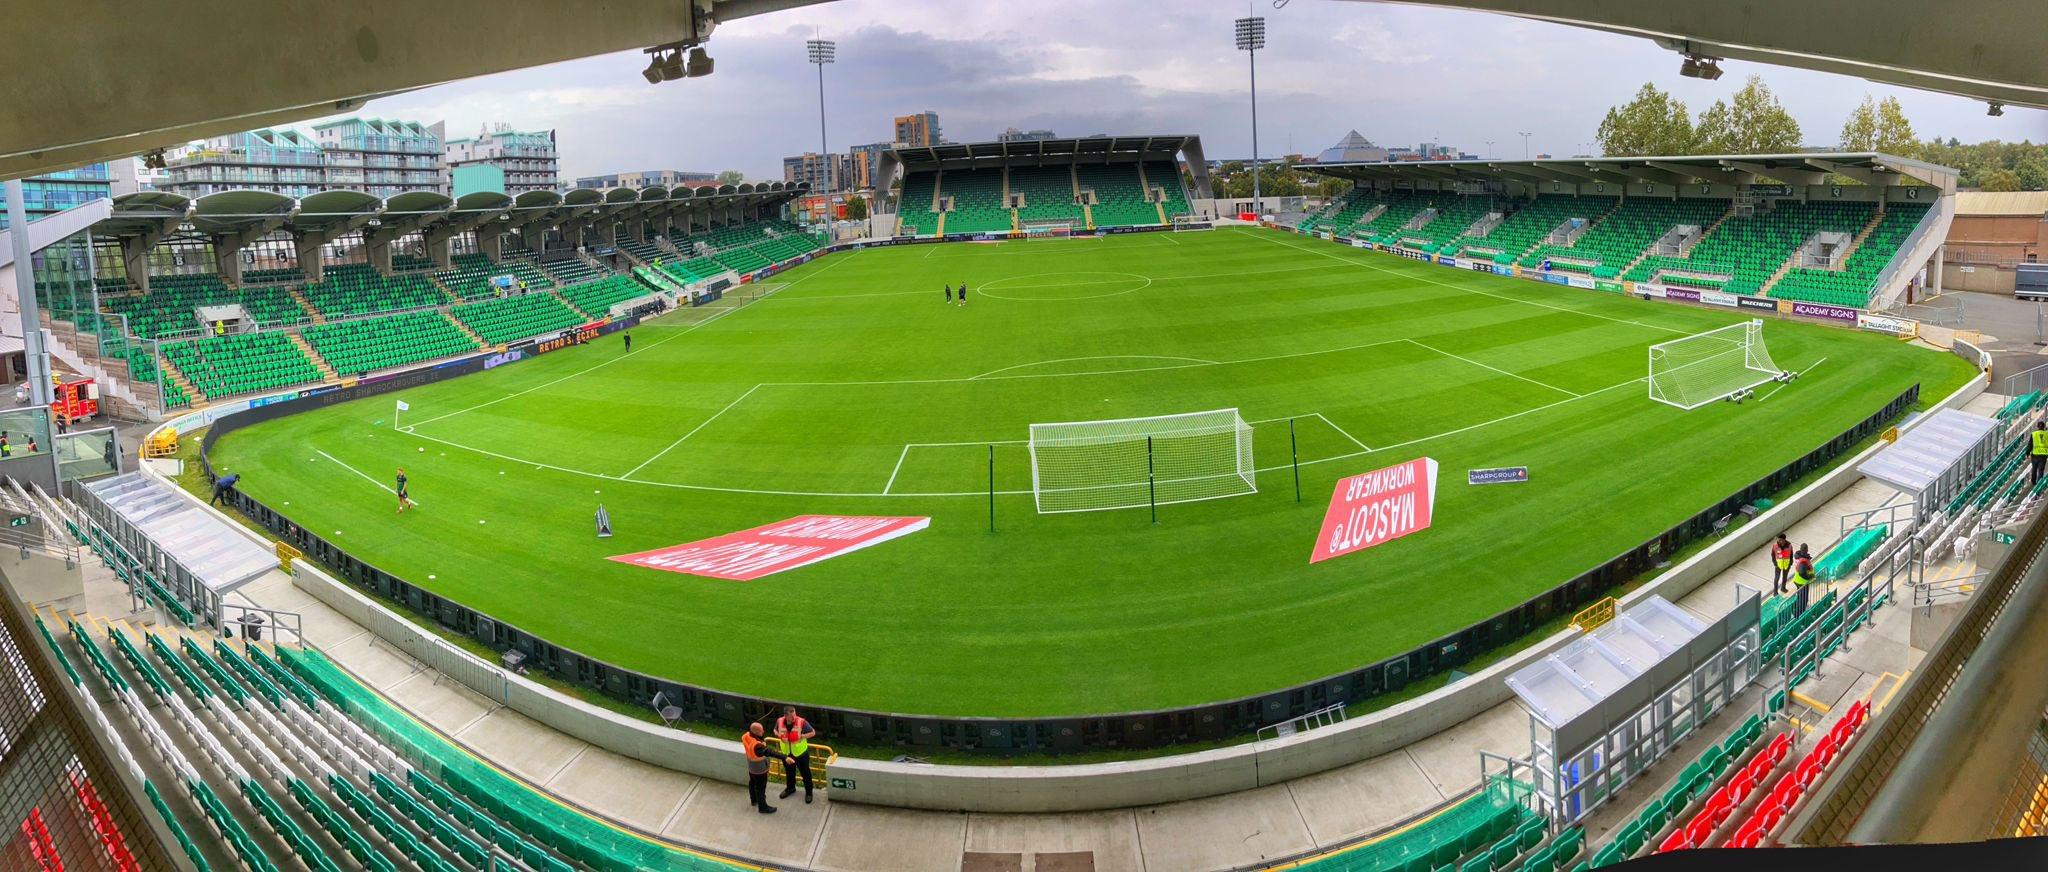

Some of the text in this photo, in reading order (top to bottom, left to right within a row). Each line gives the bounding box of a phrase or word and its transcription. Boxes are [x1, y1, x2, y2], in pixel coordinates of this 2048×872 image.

[175, 256, 183, 266] B
[244, 255, 252, 264] B
[1741, 299, 1773, 308] SKECHERS
[1795, 303, 1854, 319] ACADEMY SIGNS
[1868, 321, 1892, 332] TALLAGHT
[539, 338, 565, 353] RETRO
[567, 329, 600, 344] SECIAL
[1471, 471, 1517, 480] SHARPGROUP
[1346, 463, 1415, 501] WORKWEAR
